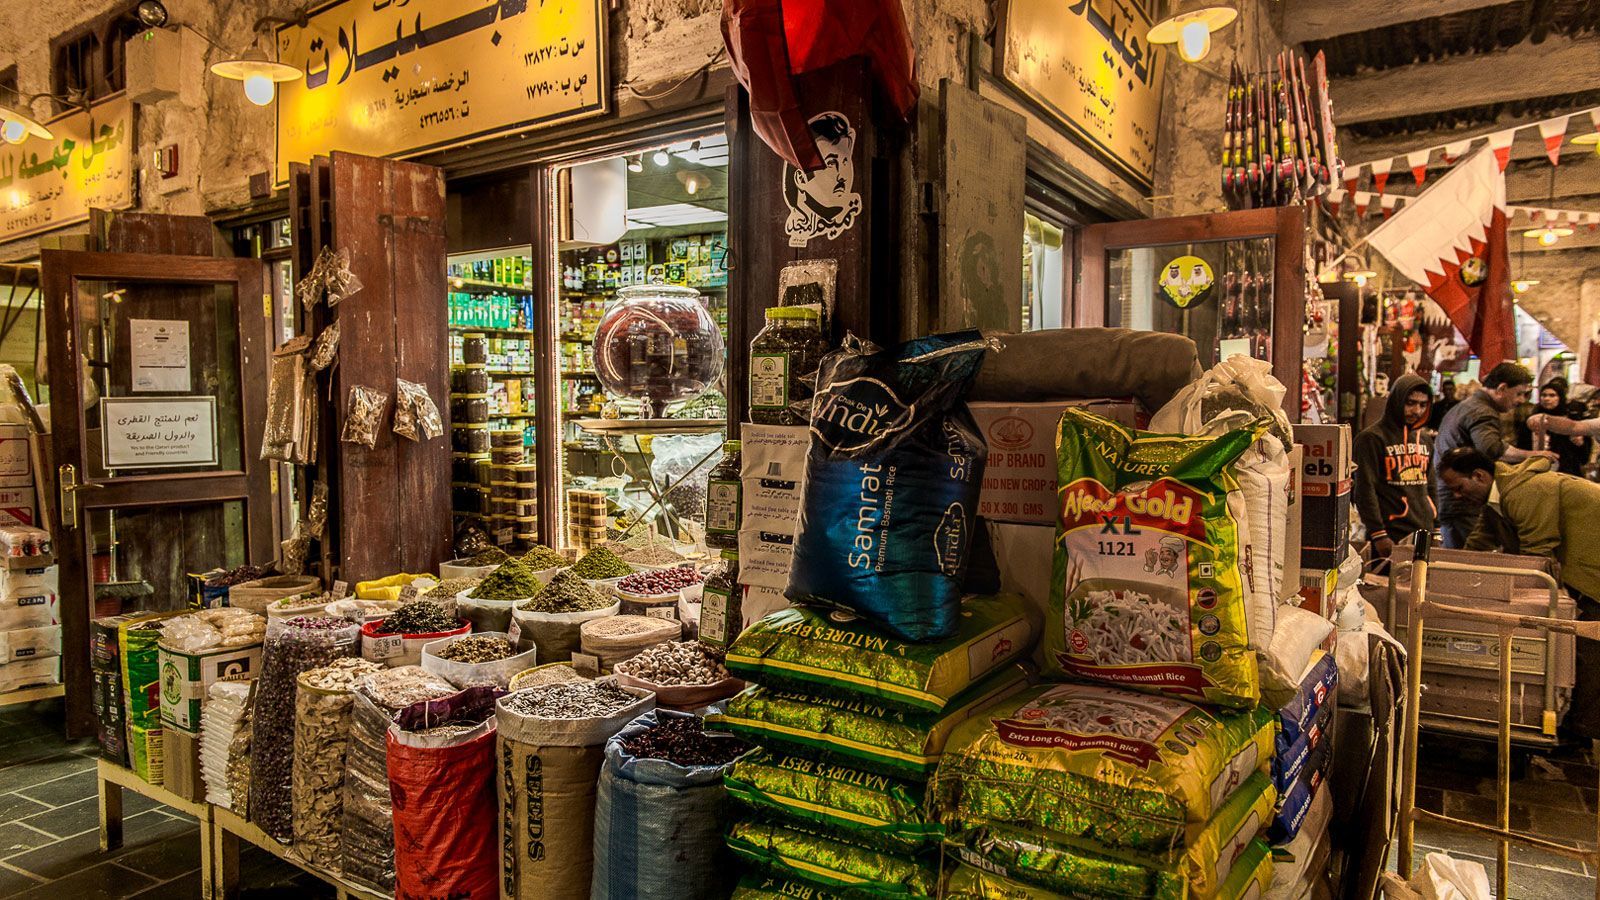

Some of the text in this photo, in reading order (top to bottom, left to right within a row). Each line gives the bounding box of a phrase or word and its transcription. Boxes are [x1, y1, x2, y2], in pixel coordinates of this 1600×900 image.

[1095, 440, 1170, 476] NATURE'S
[1386, 443, 1405, 456] PRO
[985, 453, 1045, 468] HIP BRAND
[1000, 479, 1020, 490] NEW
[1022, 480, 1046, 491] CROP
[848, 463, 882, 570] Samrat
[981, 502, 1044, 515] 50 X 300 GMS
[1125, 490, 1193, 524] Gold
[874, 466, 897, 572] Premium Basmati Rice
[1098, 541, 1136, 557] 1121
[777, 621, 889, 652] NATURE'S BEST
[1132, 672, 1165, 682] Basmati
[1166, 672, 1186, 682] Rice
[1008, 731, 1140, 753] Extra Long Grain Basmati Rice
[1014, 751, 1025, 762] 20
[778, 755, 890, 791] NATURE'S BEST
[503, 738, 516, 898] SUNFLOW
[525, 753, 545, 863] SEEDS
[780, 880, 814, 900] BEST
[1016, 889, 1026, 899] 20
